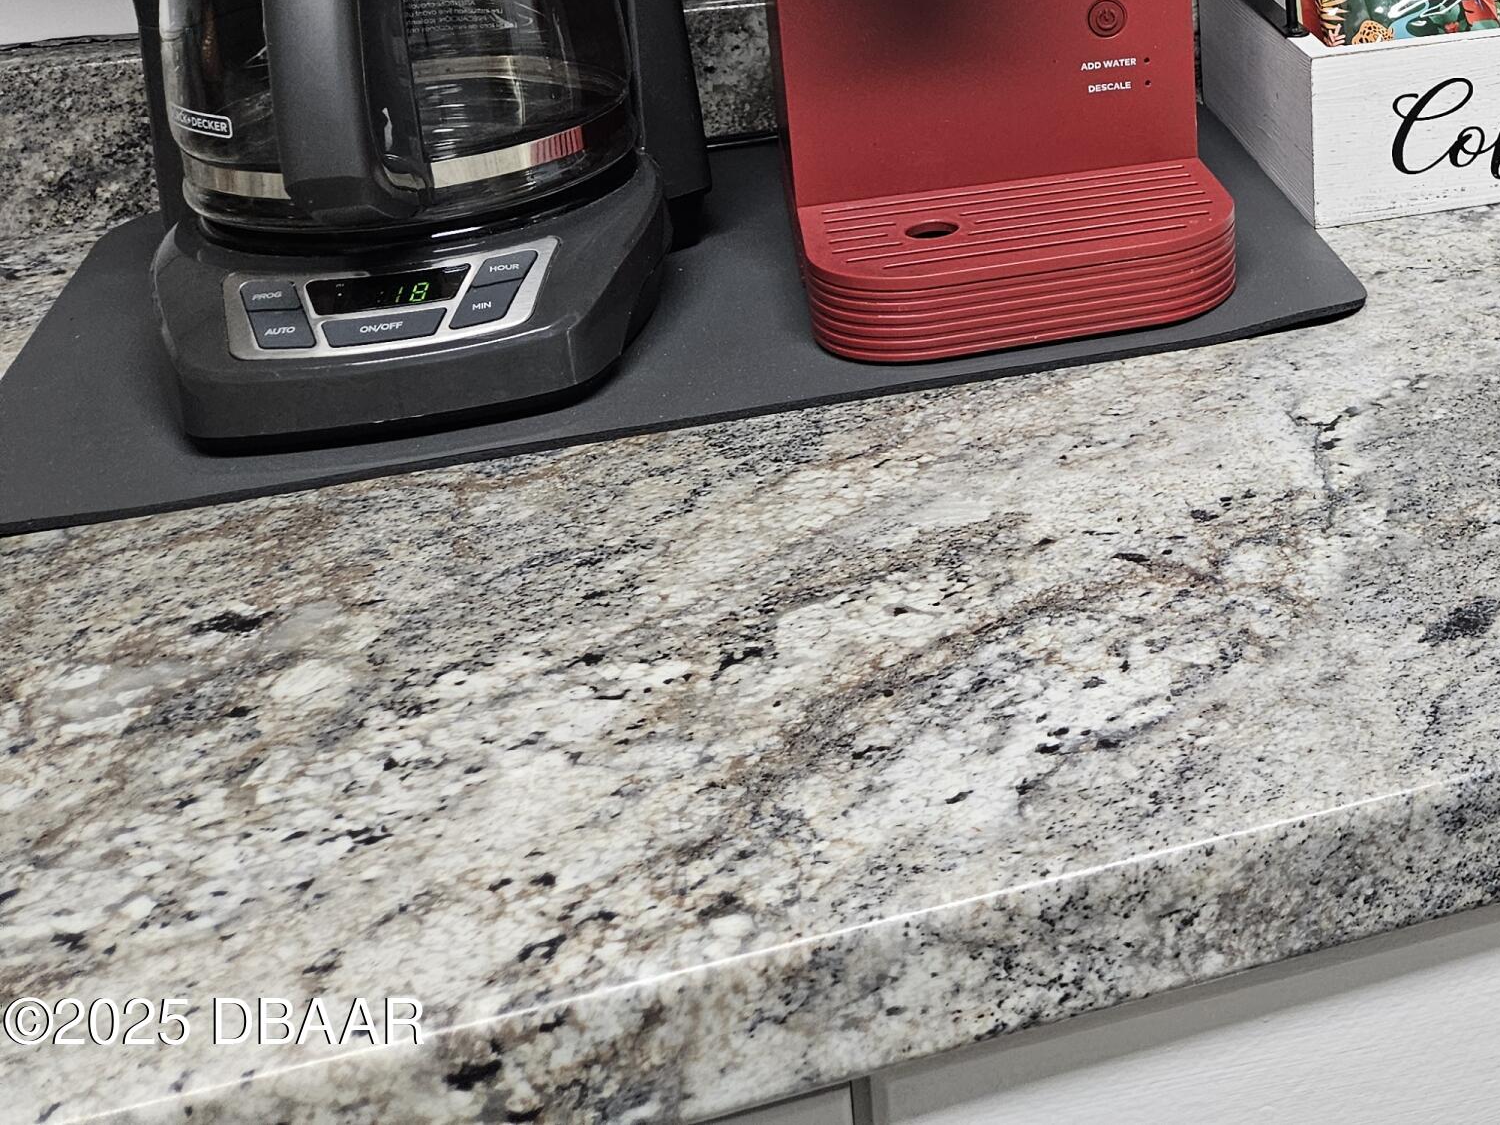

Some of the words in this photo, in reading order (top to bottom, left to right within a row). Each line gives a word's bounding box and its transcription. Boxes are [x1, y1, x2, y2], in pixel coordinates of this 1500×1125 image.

[1081, 62, 1102, 71] ADD
[1103, 57, 1137, 69] WATER
[1088, 81, 1132, 94] DESCALE
[489, 263, 520, 273] HOUR
[252, 290, 283, 301] PROG
[472, 301, 492, 311] MIN
[264, 326, 296, 336] AUTO
[359, 321, 404, 334] ON/OFF
